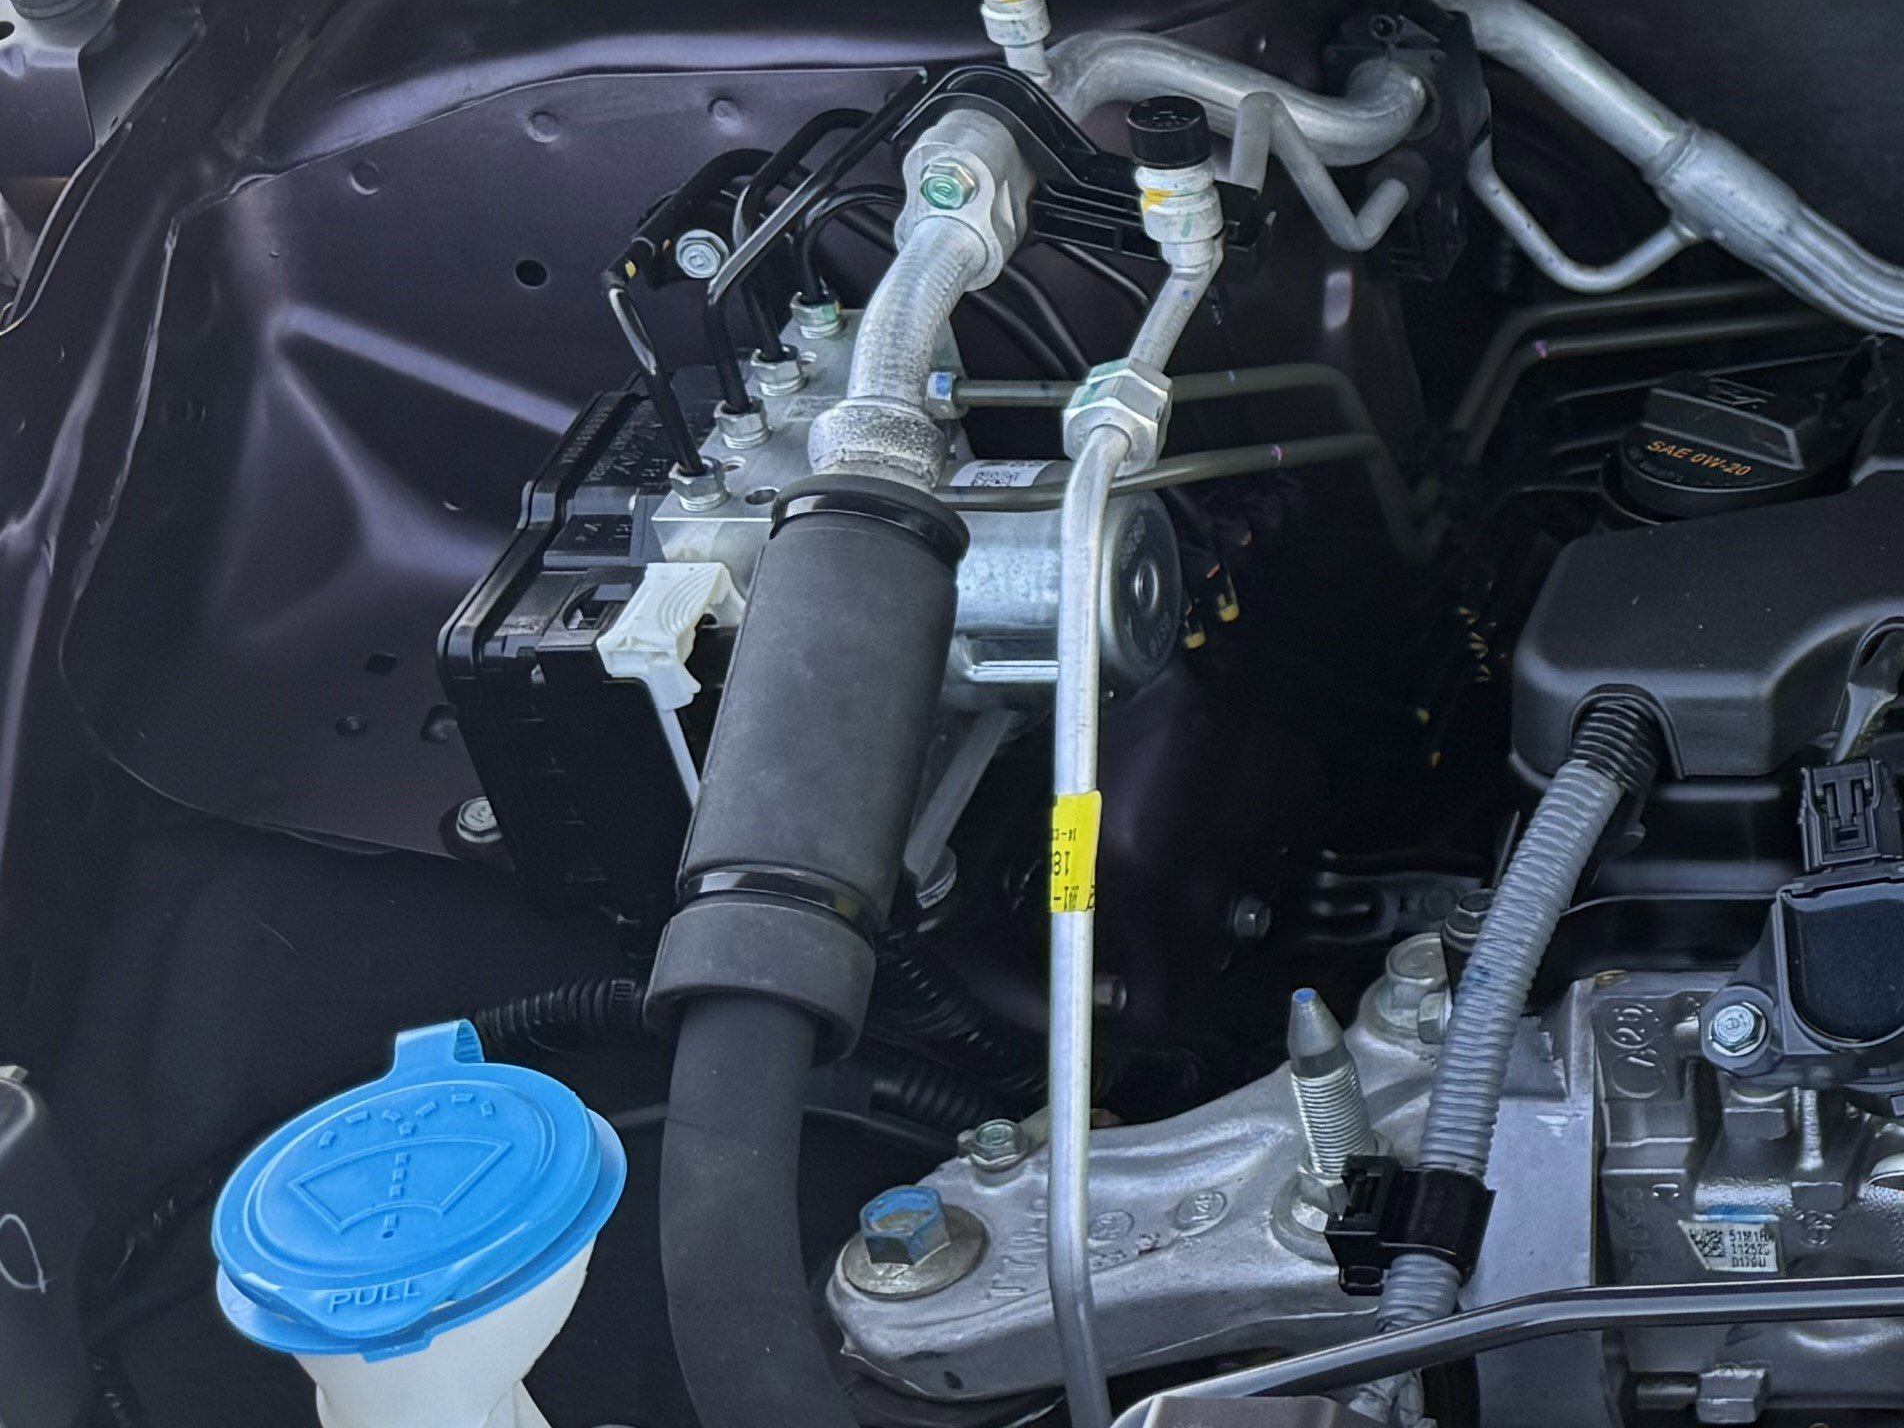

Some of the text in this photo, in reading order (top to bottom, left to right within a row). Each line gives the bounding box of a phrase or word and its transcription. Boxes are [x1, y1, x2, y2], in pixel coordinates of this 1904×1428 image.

[1647, 441, 1752, 476] SAE 0W-20
[328, 1278, 421, 1313] PULL
